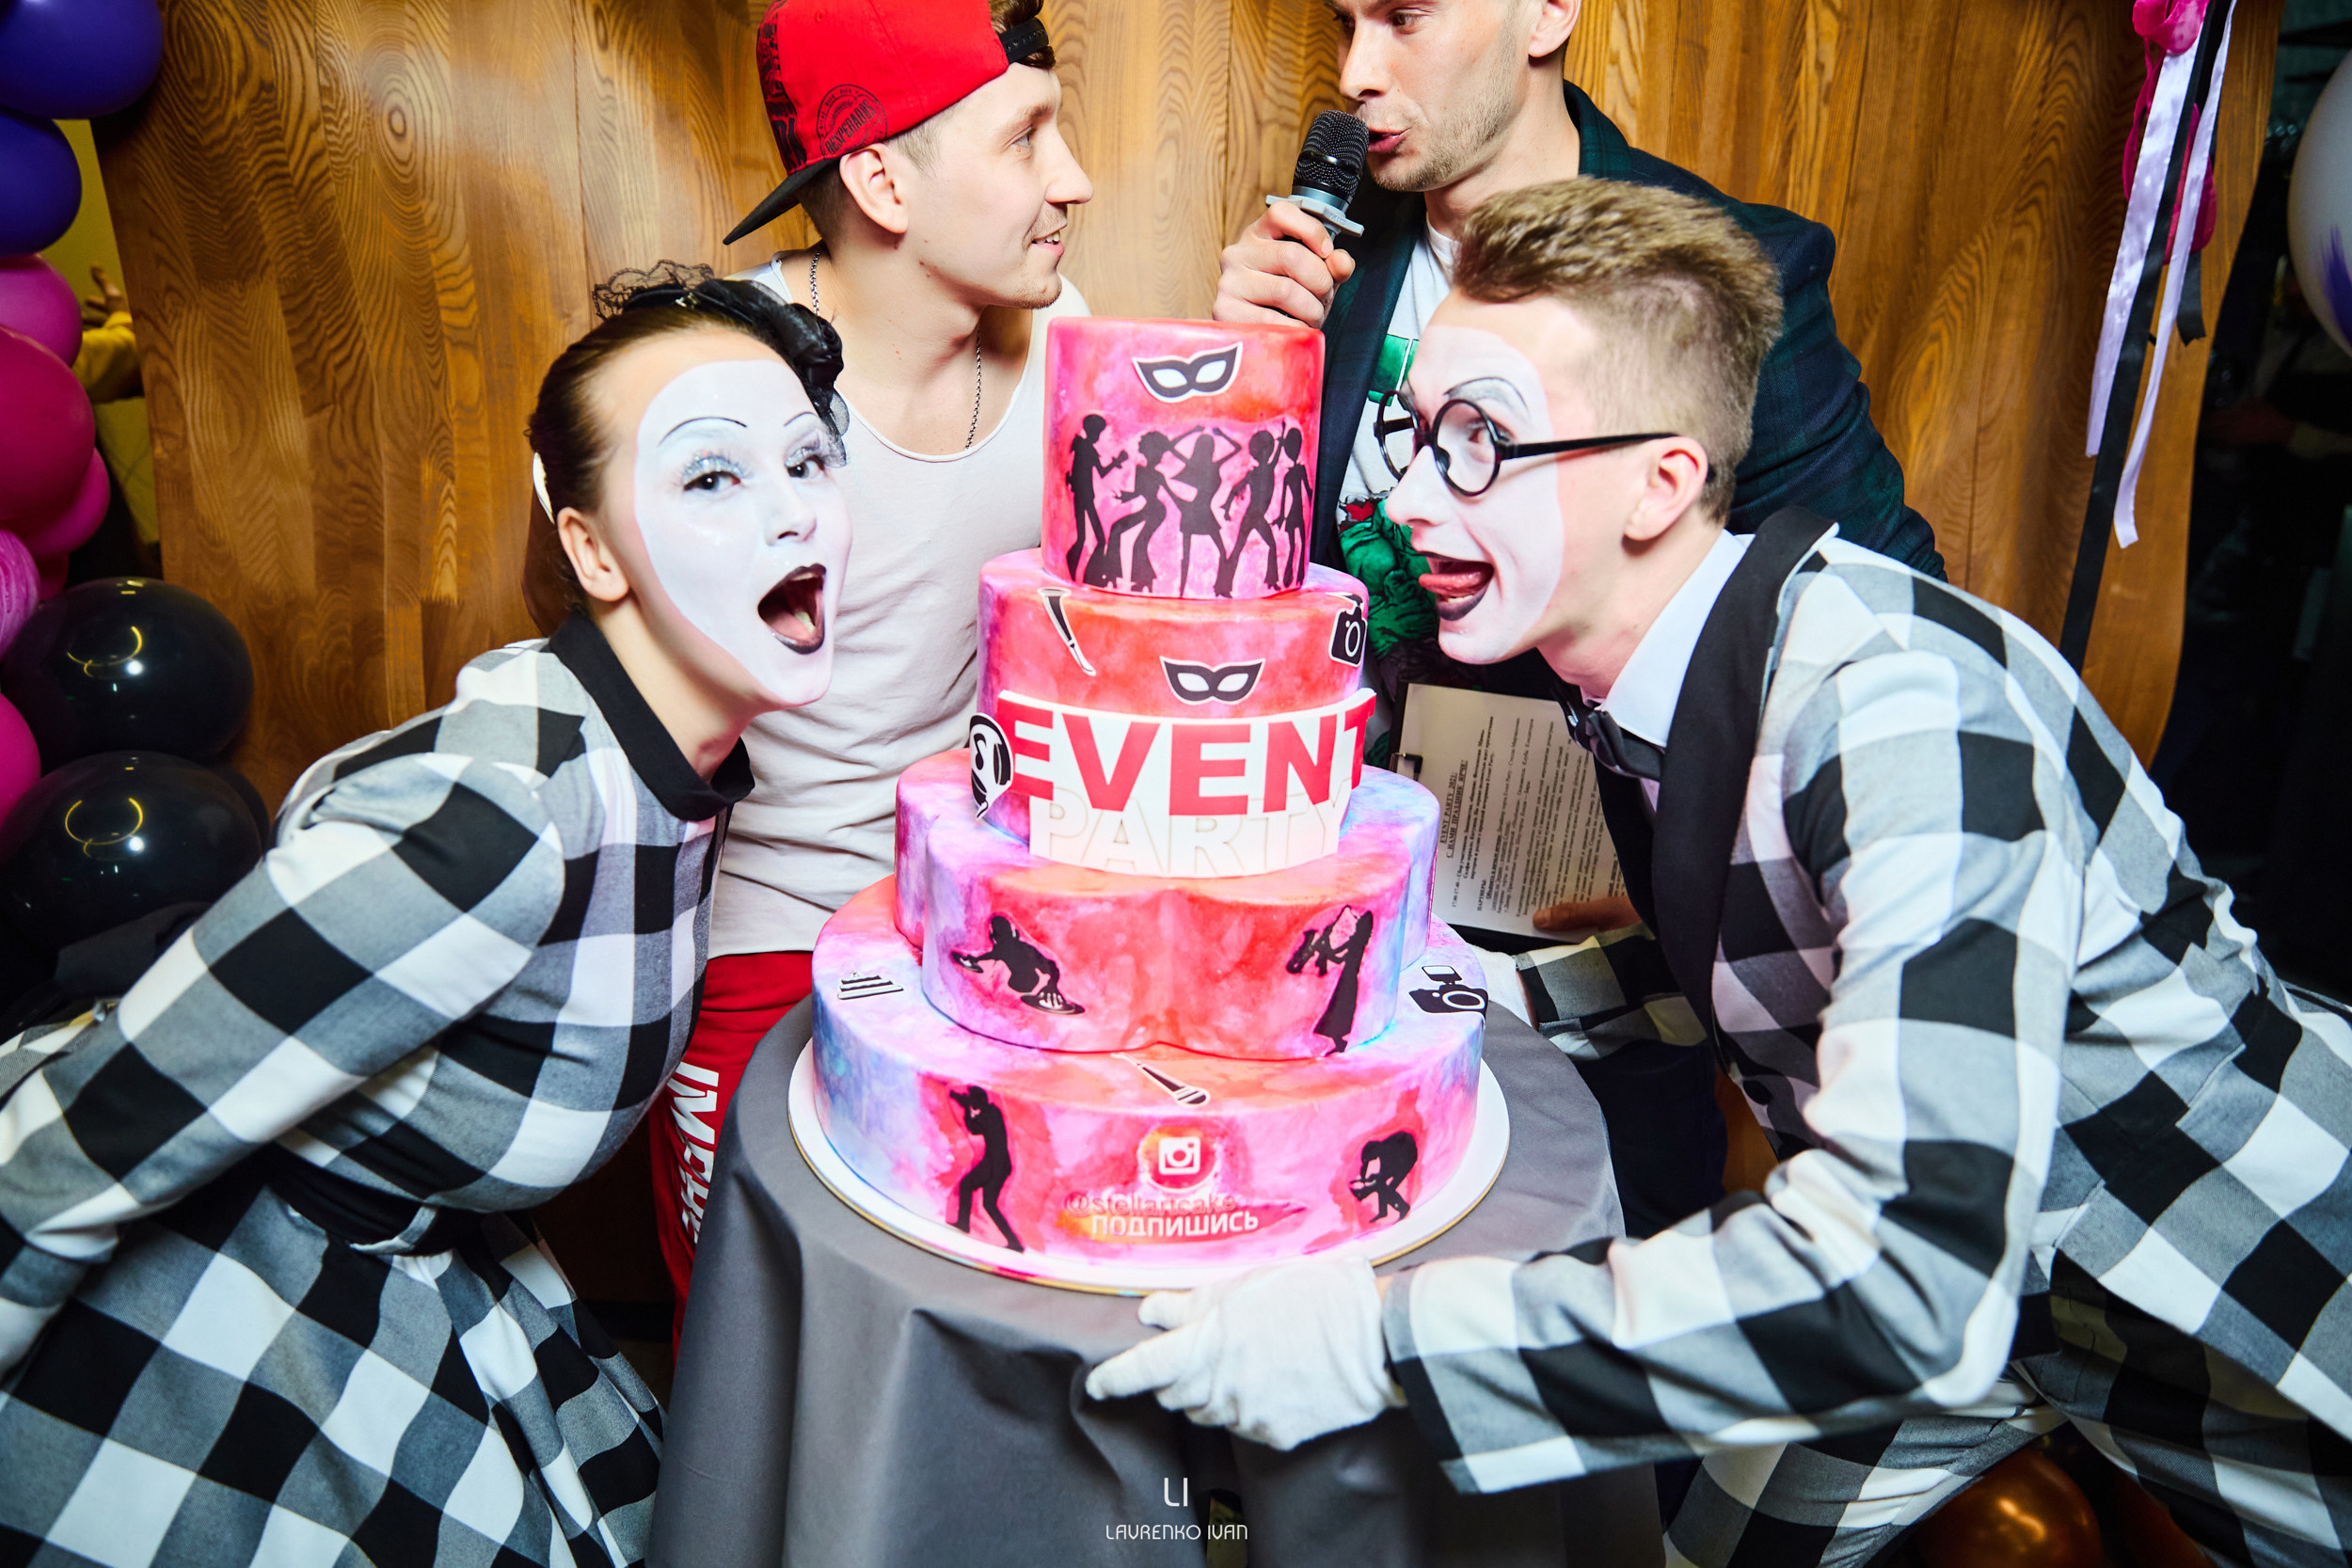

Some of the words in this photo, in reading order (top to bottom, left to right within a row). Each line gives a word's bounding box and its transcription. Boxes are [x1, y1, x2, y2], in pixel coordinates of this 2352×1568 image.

[825, 99, 877, 155] DESPERADOS
[997, 697, 1375, 816] EVENT
[1047, 778, 1352, 875] PARTY
